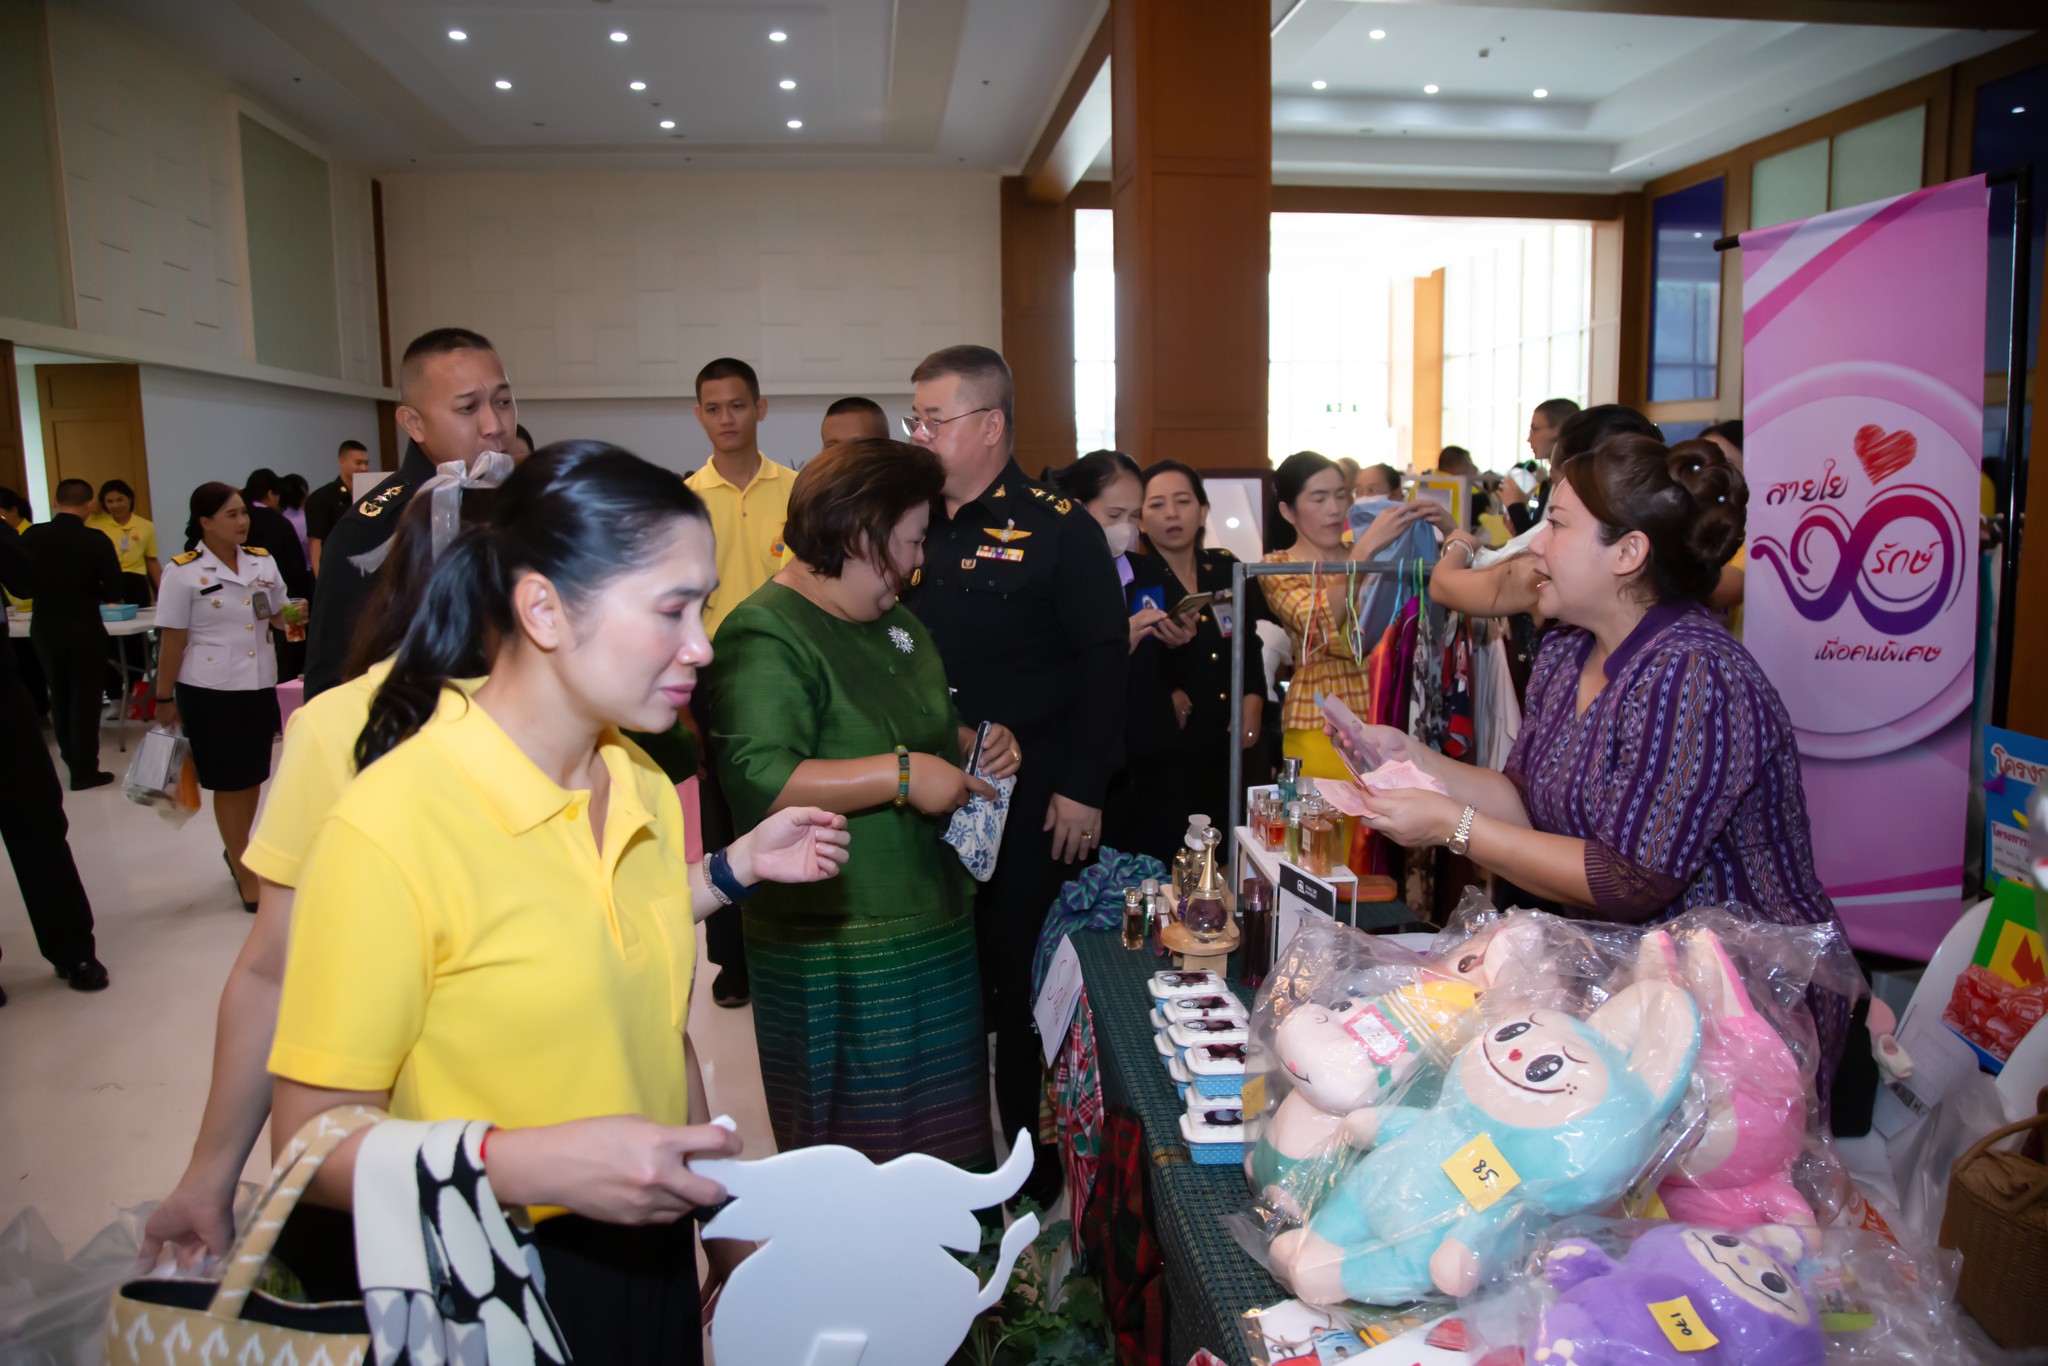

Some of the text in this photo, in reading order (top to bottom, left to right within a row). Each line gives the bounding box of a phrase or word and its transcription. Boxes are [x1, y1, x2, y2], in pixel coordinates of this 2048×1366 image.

[1765, 458, 1849, 505] สายใย
[1871, 541, 1942, 575] รักษ์
[1814, 636, 1943, 663] เพื่อคนพิเศษ
[1669, 1311, 1693, 1338] 170
